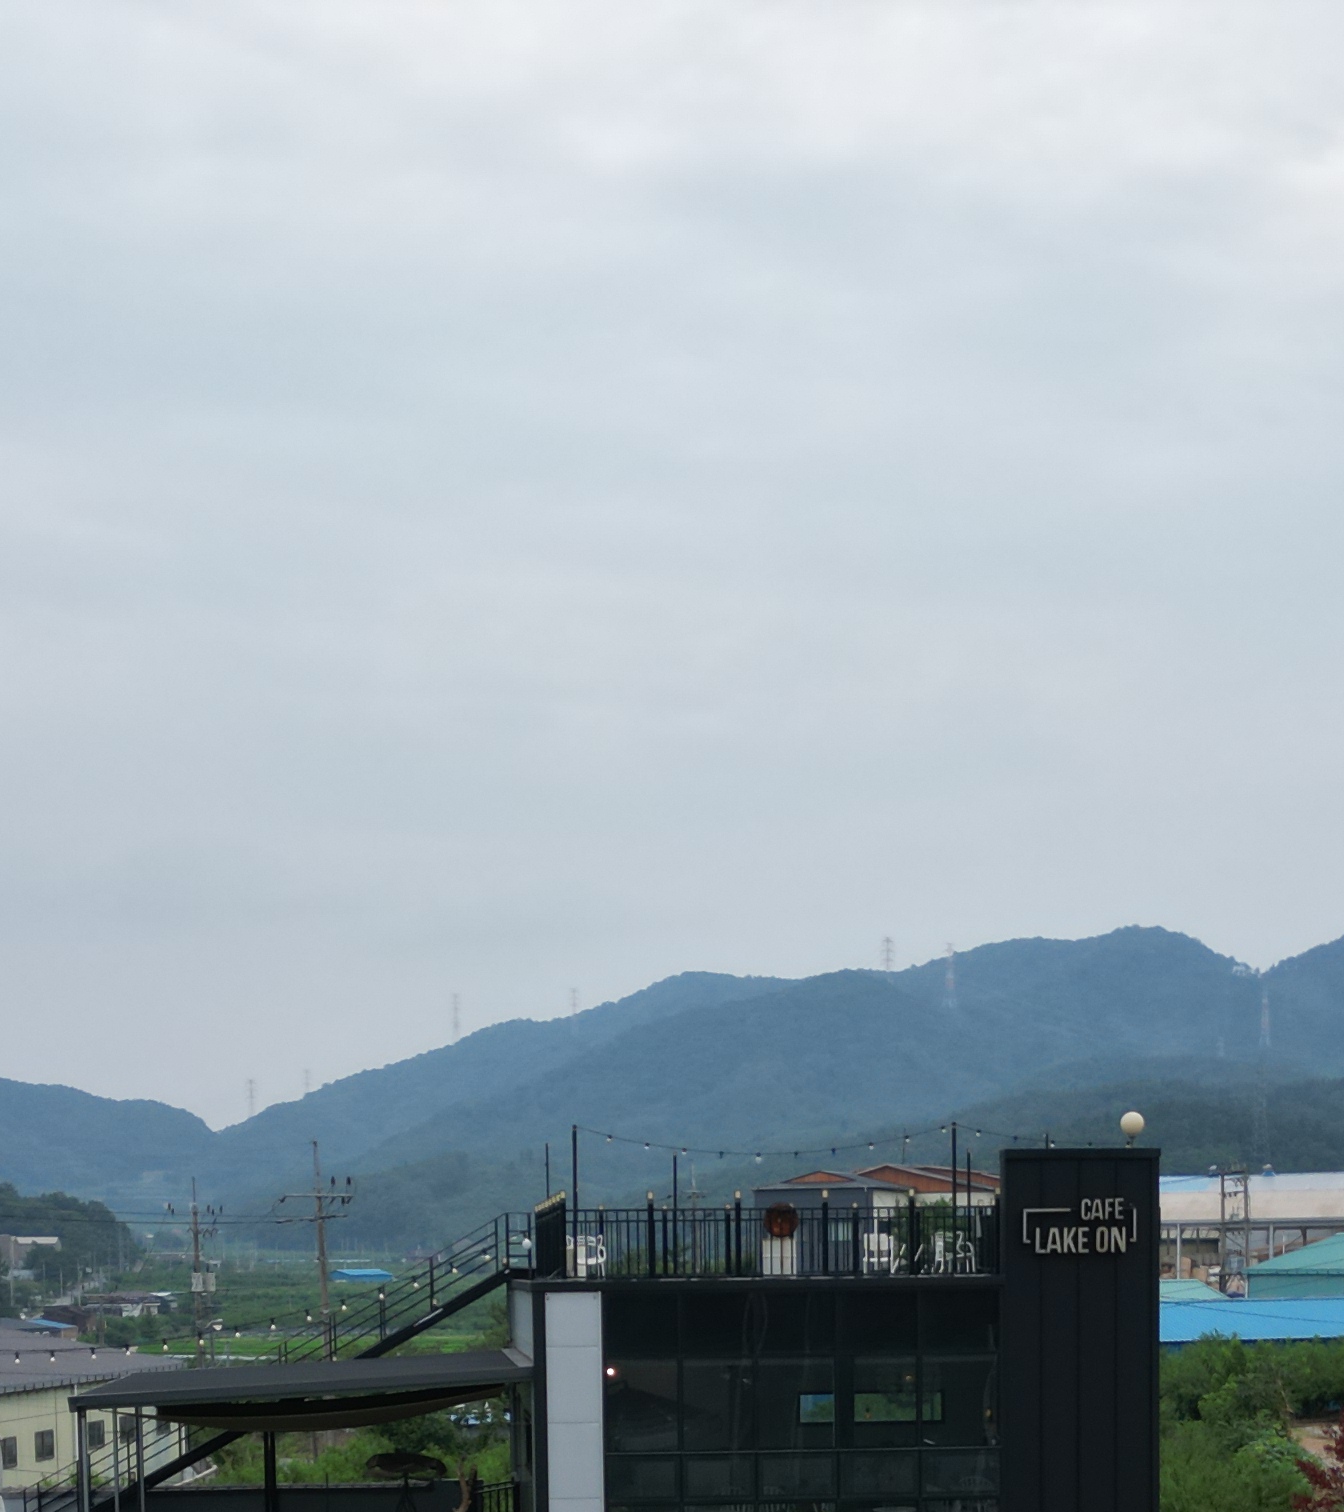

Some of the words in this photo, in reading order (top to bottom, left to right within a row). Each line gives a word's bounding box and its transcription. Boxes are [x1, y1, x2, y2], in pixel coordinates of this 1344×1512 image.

[1080, 1198, 1124, 1221] CAFE
[1035, 1227, 1090, 1254] LAKE
[1096, 1226, 1127, 1253] ON
